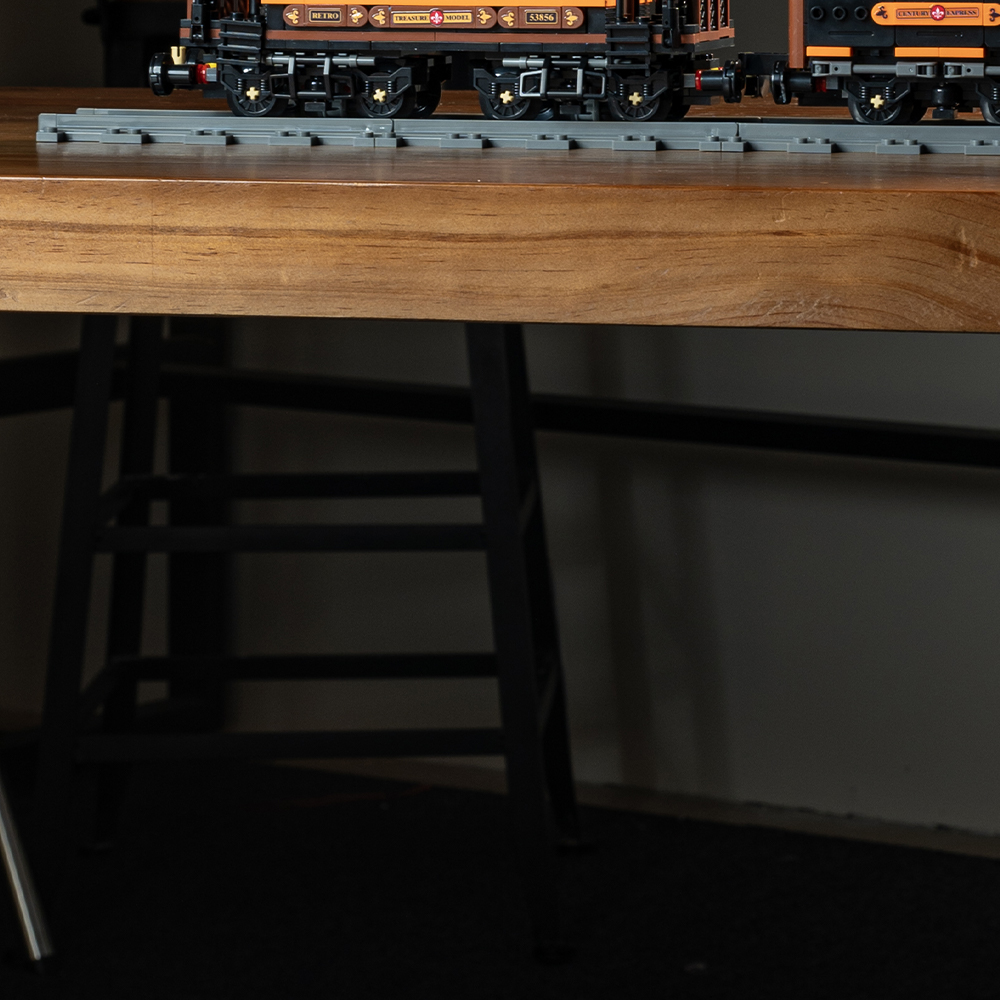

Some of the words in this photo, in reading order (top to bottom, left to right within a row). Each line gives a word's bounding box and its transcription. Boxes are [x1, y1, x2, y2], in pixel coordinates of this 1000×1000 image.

[312, 12, 339, 21] RETRO
[394, 14, 428, 22] TREASURE
[445, 14, 471, 22] MODEL
[528, 12, 555, 22] 53856
